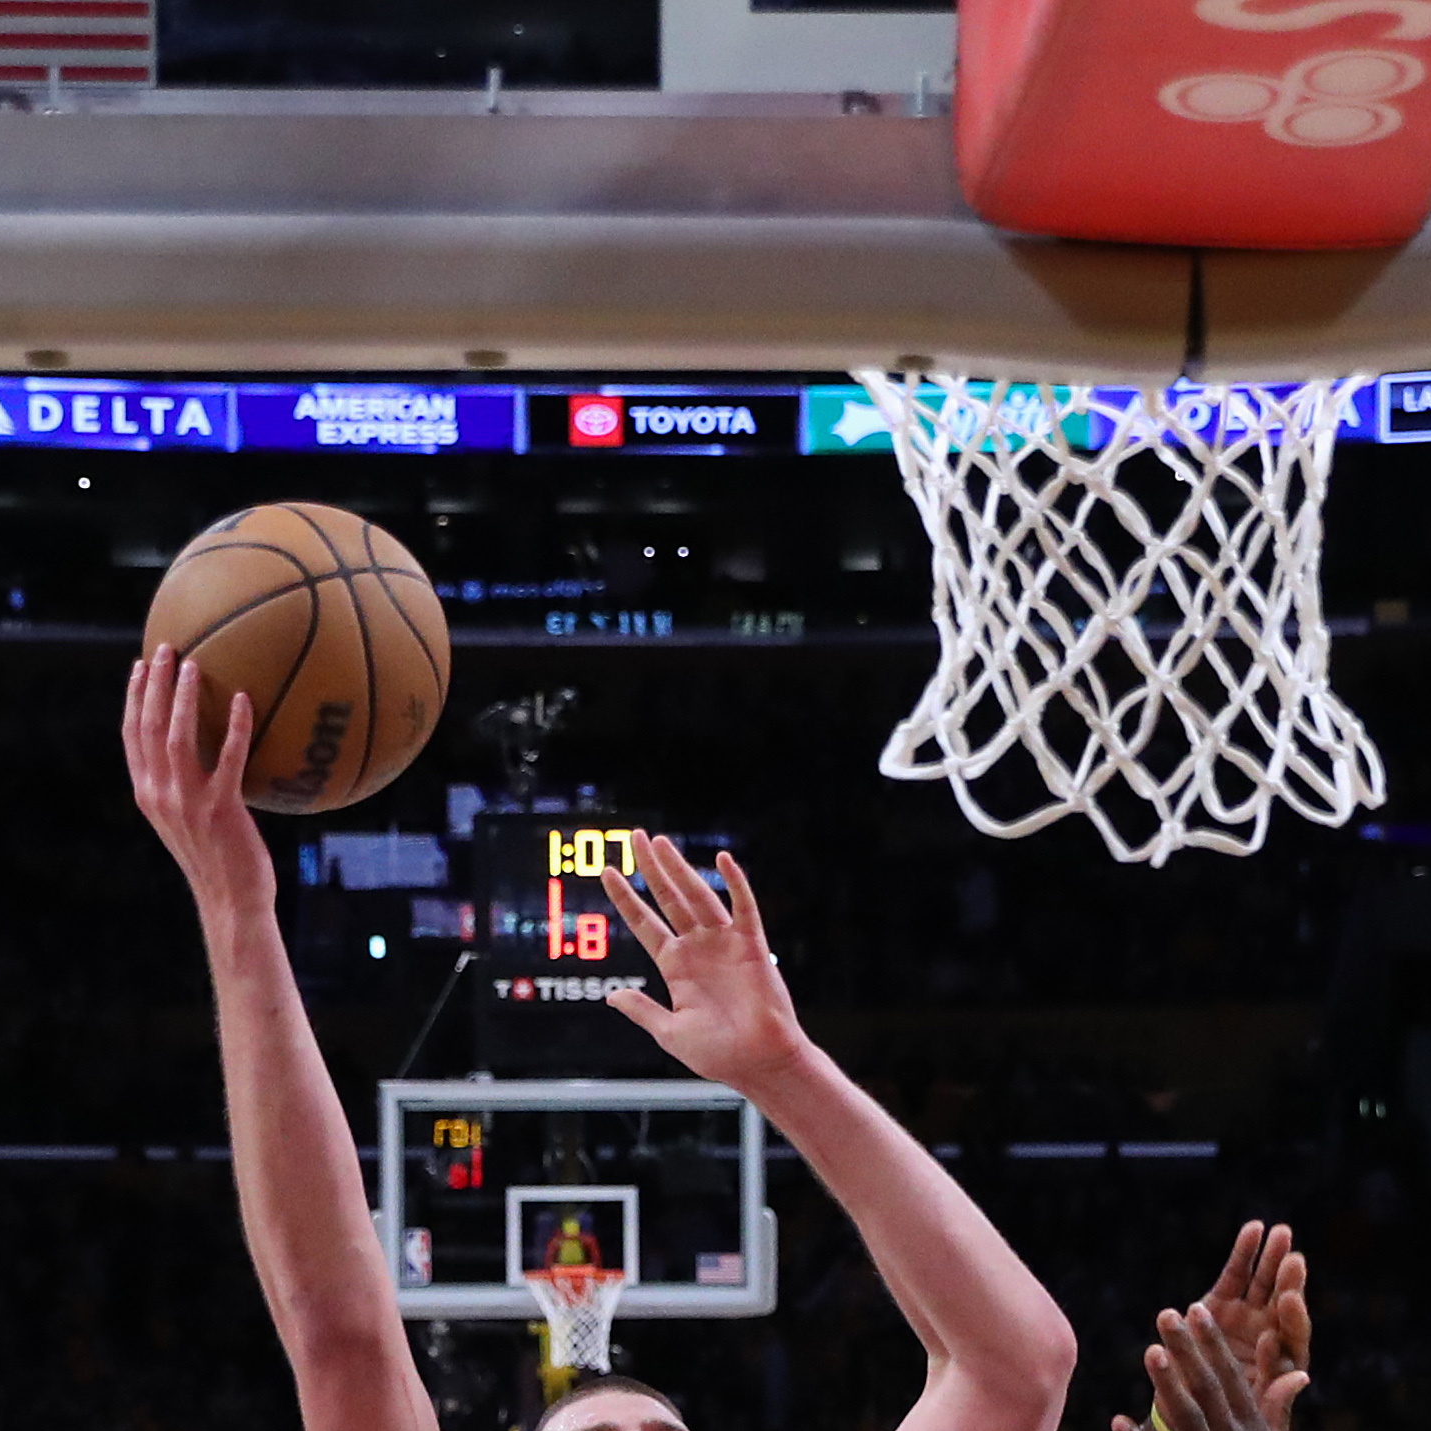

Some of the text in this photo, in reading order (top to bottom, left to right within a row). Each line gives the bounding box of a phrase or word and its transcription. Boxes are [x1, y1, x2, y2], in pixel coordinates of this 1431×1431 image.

[28, 393, 212, 436] DELTA
[294, 393, 457, 422] AMERICAN
[629, 406, 757, 436] TOYOTA
[316, 421, 459, 446] EXPRESS
[549, 829, 636, 877] 1:07
[548, 877, 609, 960] 1.8
